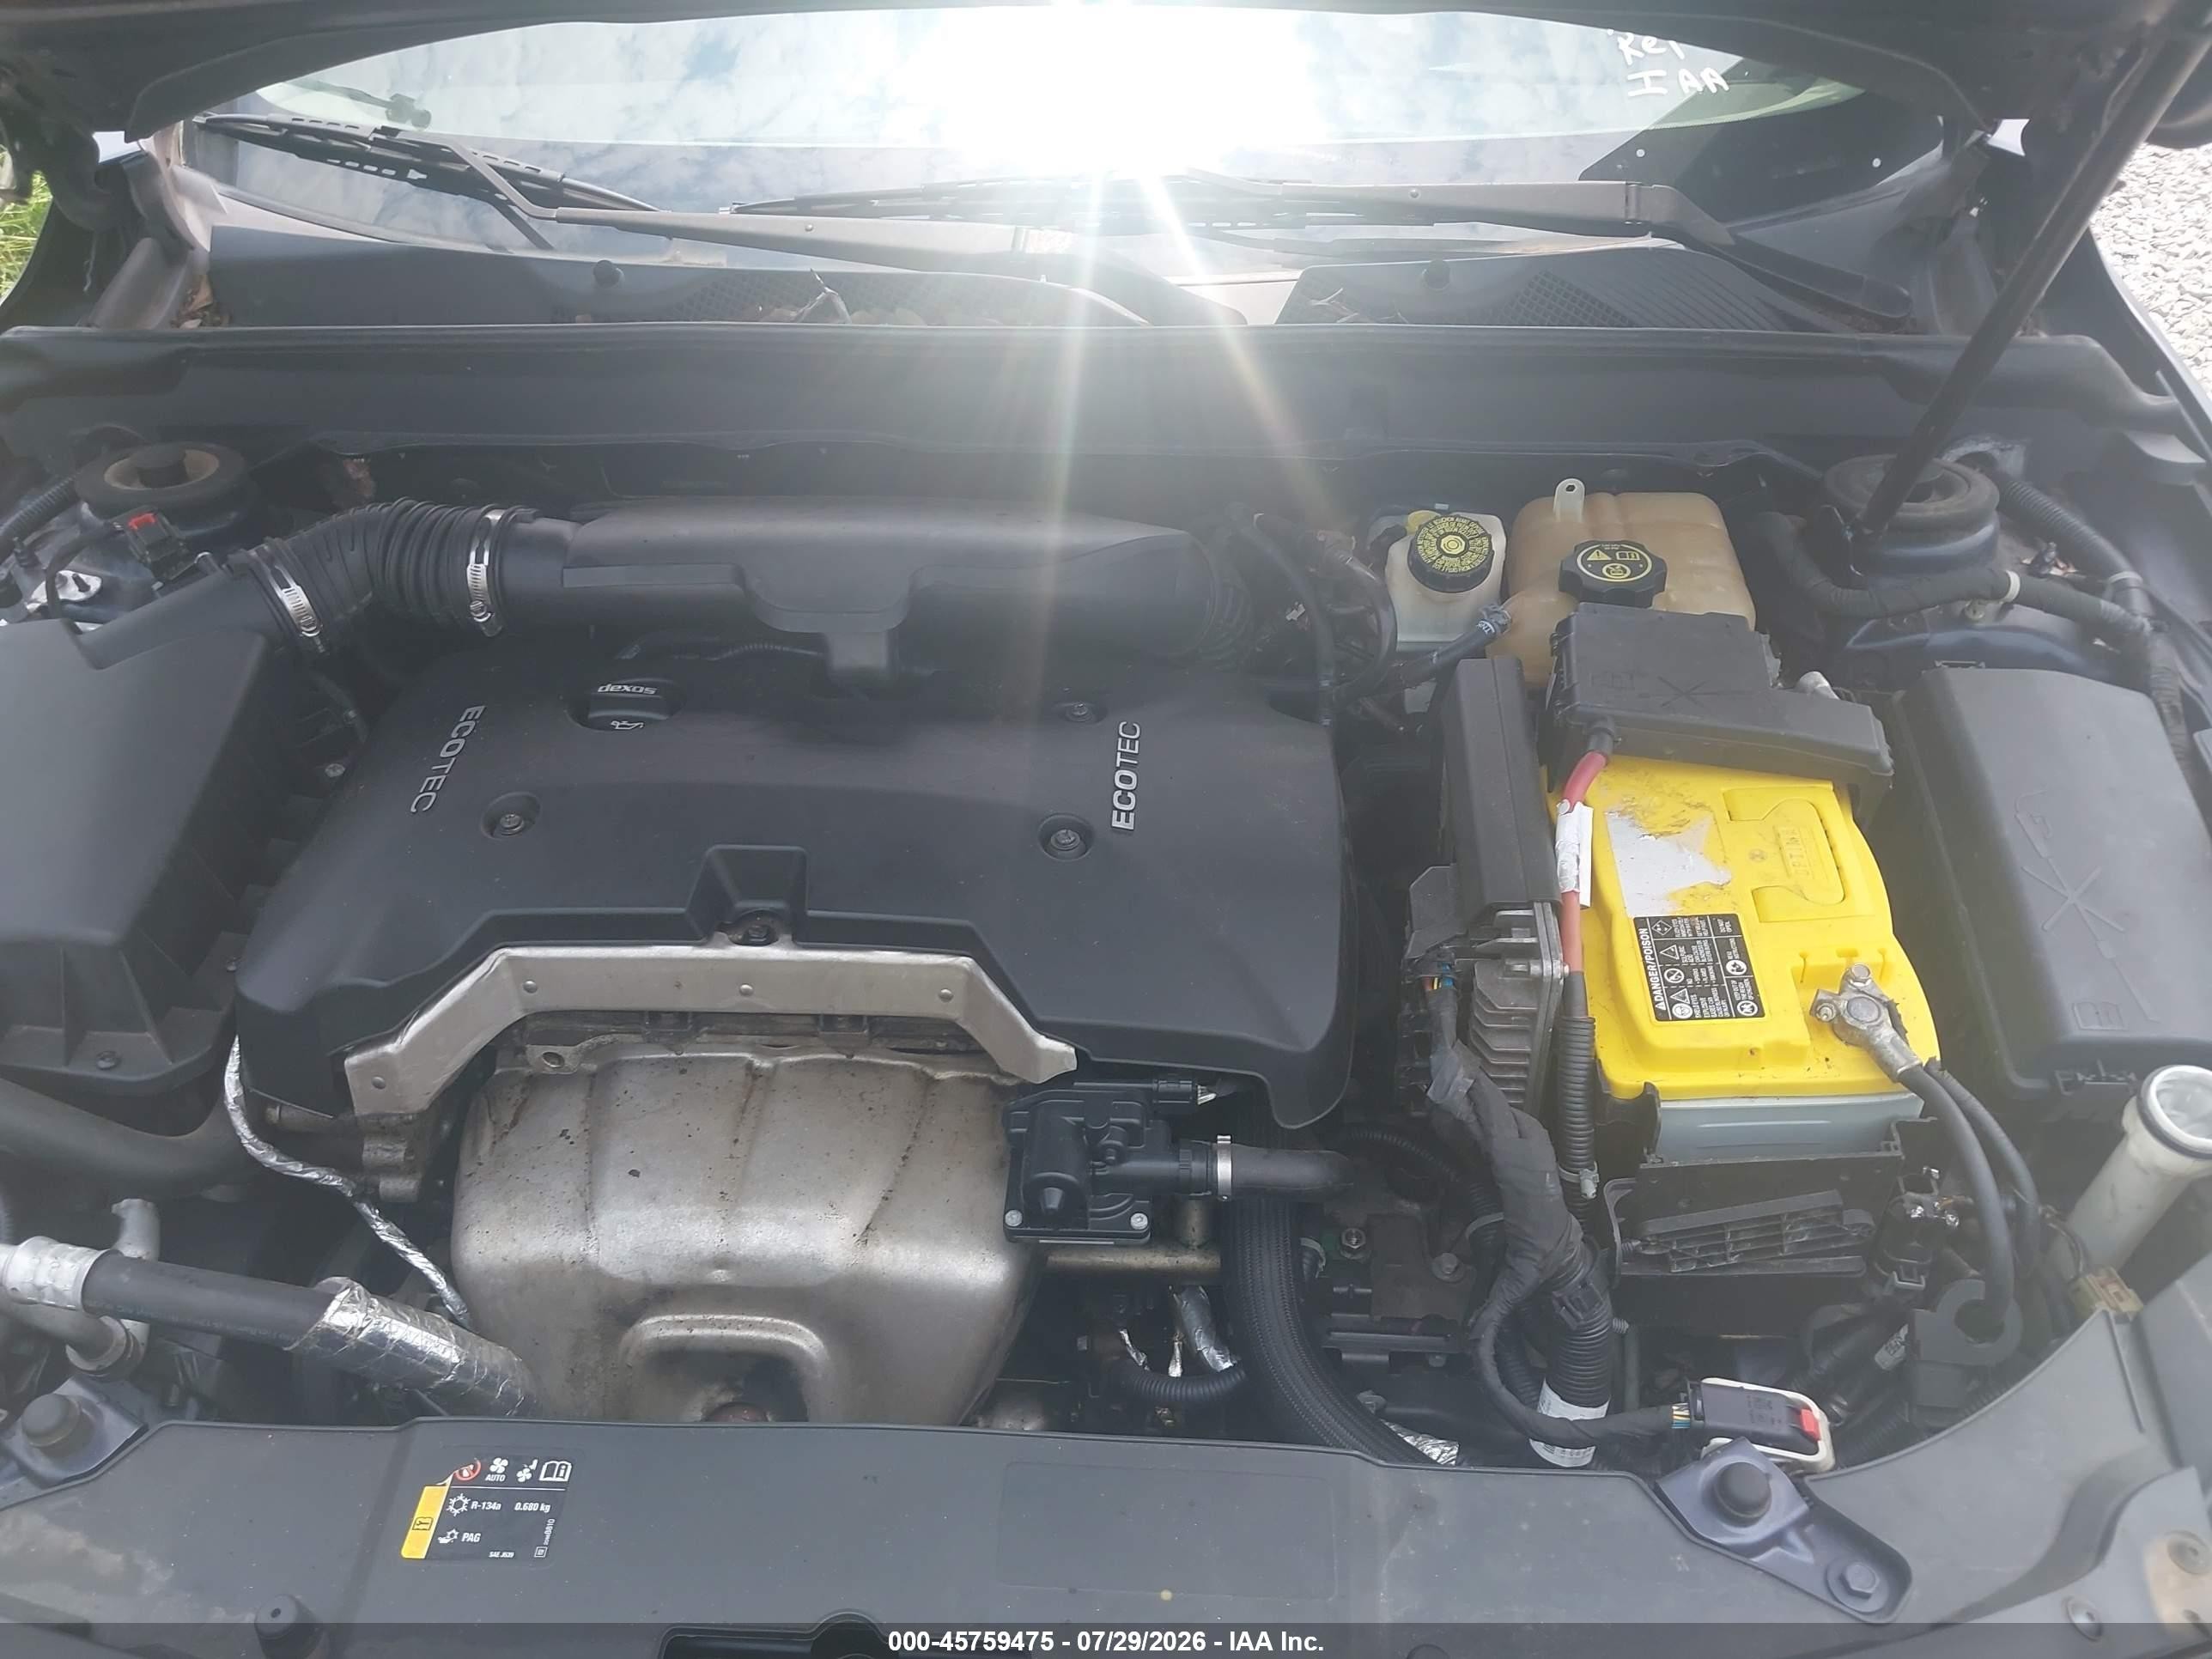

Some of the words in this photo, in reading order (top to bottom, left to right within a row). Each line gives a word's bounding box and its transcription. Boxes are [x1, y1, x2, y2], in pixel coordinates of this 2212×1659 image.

[598, 684, 657, 695] dexos
[410, 705, 487, 813] ECOTEC
[1111, 721, 1141, 830] ECOTEC
[1638, 927, 1664, 1001] DANGER/POISON
[471, 1502, 501, 1510] R-134a
[514, 1502, 538, 1511] 0.680
[540, 1503, 550, 1513] kg
[461, 1532, 481, 1542] PAG
